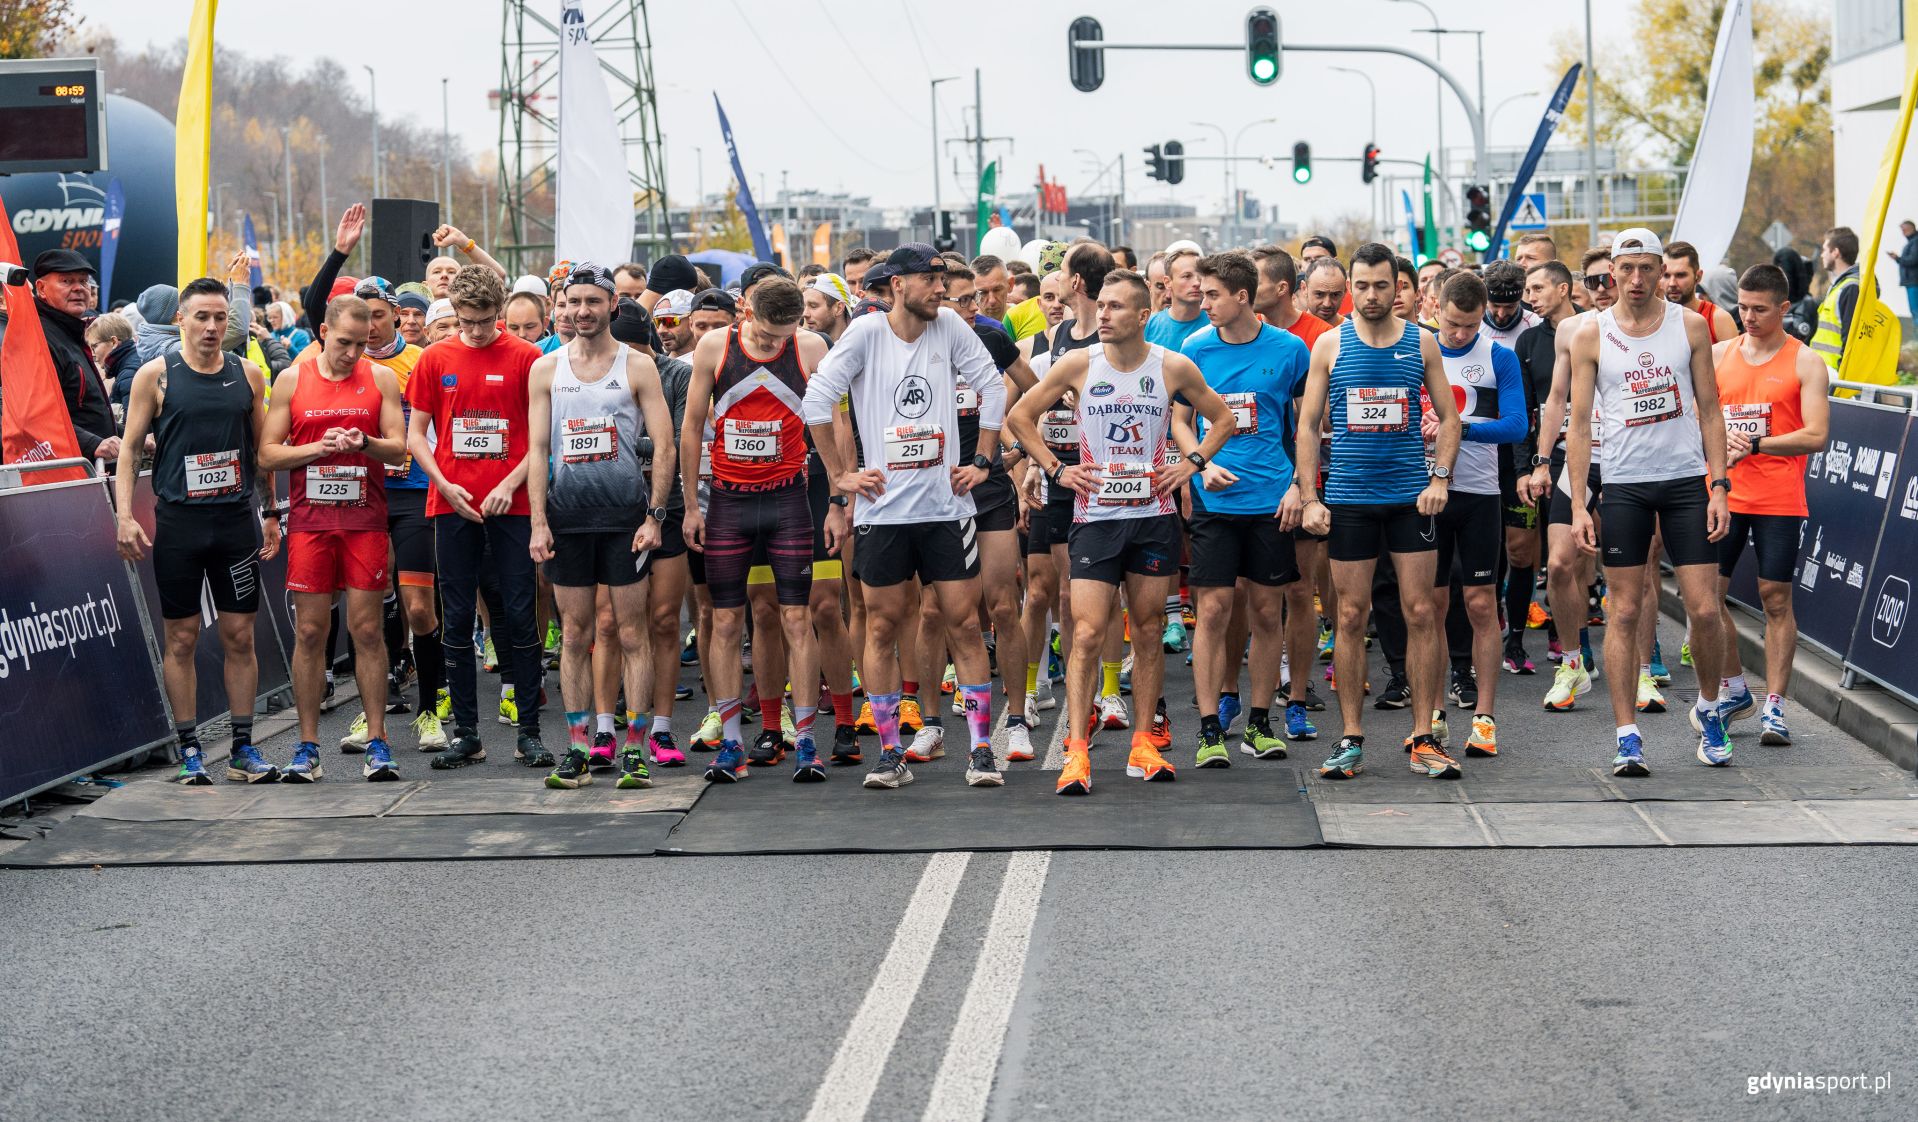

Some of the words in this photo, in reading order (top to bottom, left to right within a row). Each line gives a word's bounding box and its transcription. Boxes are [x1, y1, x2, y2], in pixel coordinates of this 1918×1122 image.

[13, 208, 106, 234] GDYNI
[1624, 366, 1672, 382] POLSKA
[901, 388, 926, 406] AR
[1088, 403, 1163, 418] DĄBROWSKI
[1634, 397, 1666, 413] 1982
[314, 408, 370, 417] DOMESTA
[1361, 407, 1387, 419] 324
[464, 436, 489, 448] 465
[570, 436, 599, 450] 1891
[735, 439, 766, 451] 1360
[901, 444, 925, 457] 251
[1109, 446, 1144, 456] TEAM
[198, 470, 227, 484] 1032
[319, 483, 349, 495] 1235
[730, 477, 795, 492] TECHFIT
[1104, 481, 1142, 493] 2004
